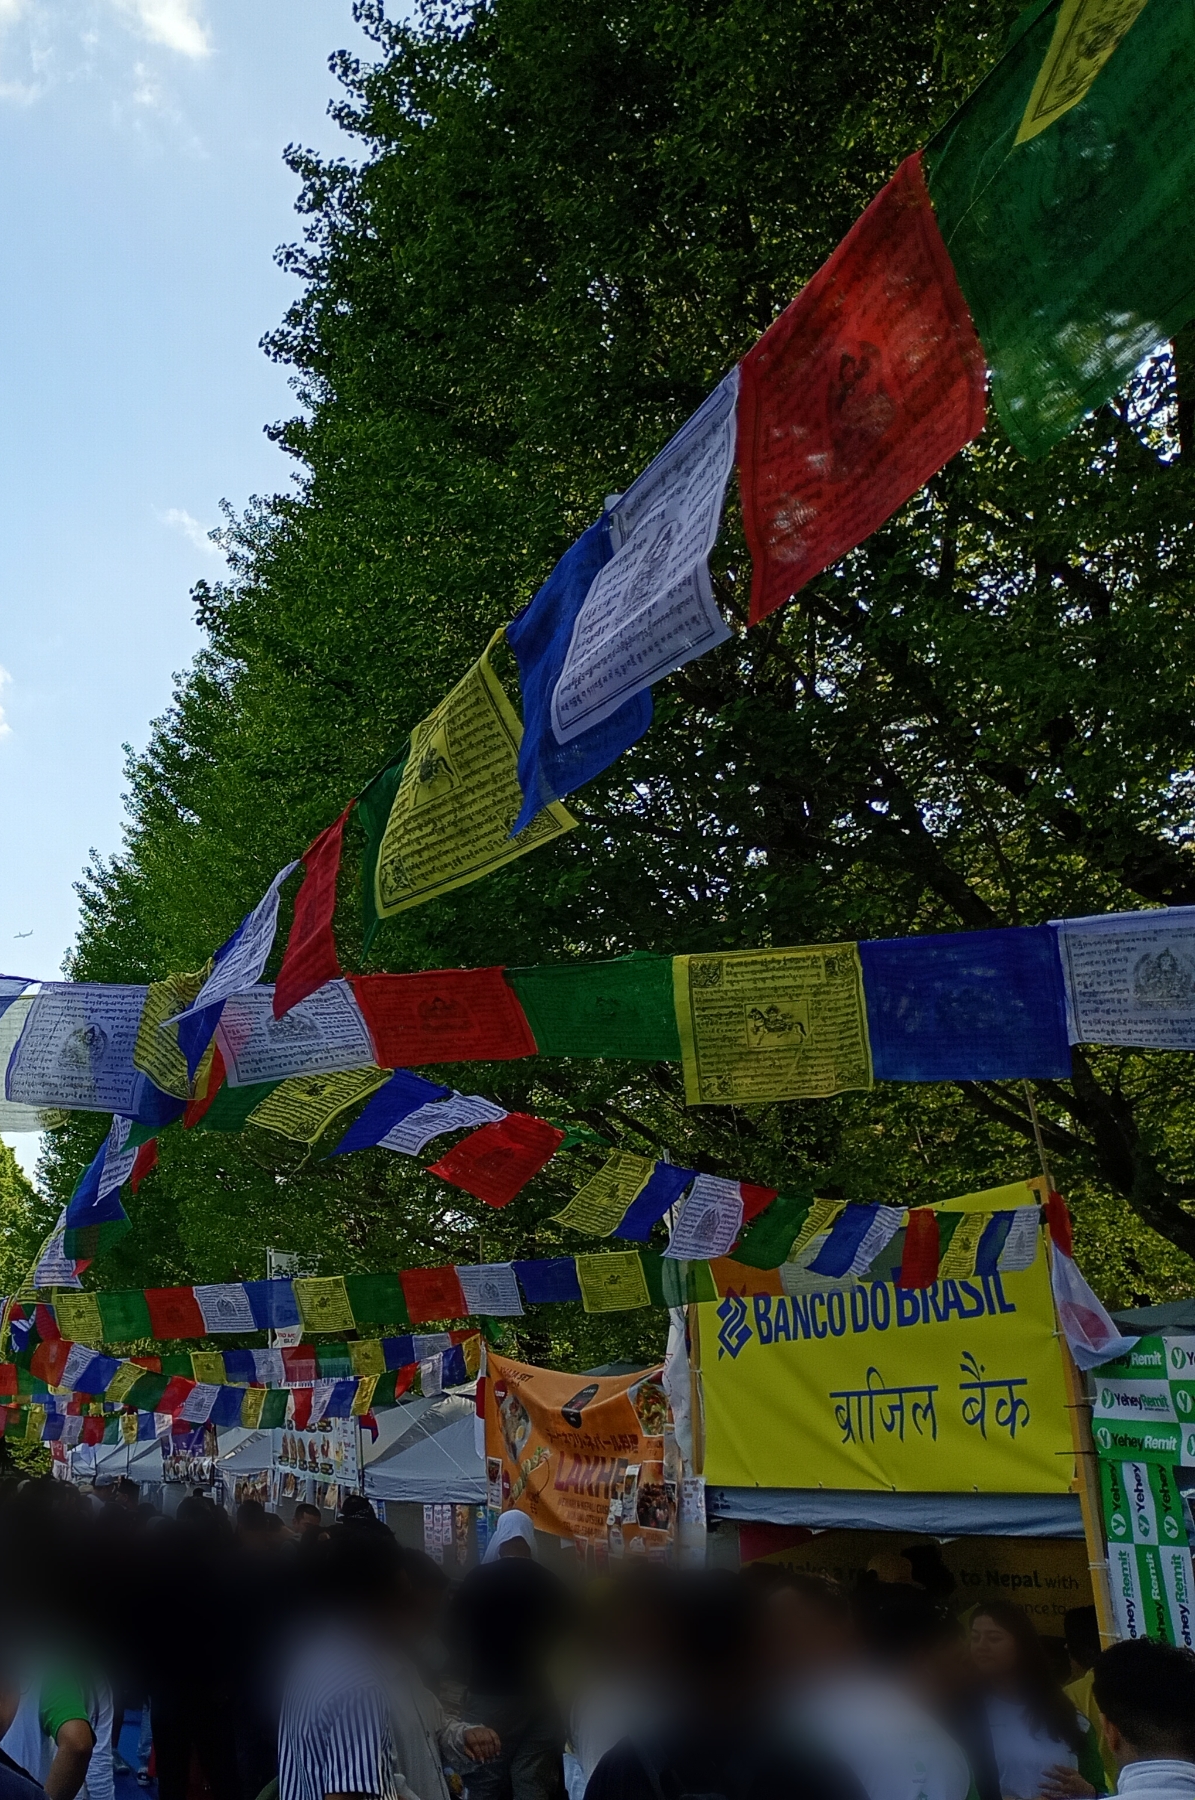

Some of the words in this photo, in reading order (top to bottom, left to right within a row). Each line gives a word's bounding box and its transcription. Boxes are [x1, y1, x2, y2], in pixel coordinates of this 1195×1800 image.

[753, 1288, 846, 1345] BANCO
[853, 1280, 890, 1333] DO
[891, 1267, 1016, 1327] BRASIL
[959, 1350, 1030, 1441] बैंक
[960, 1569, 981, 1587] to
[986, 1569, 1041, 1591] Nepal
[1044, 1575, 1080, 1590] with
